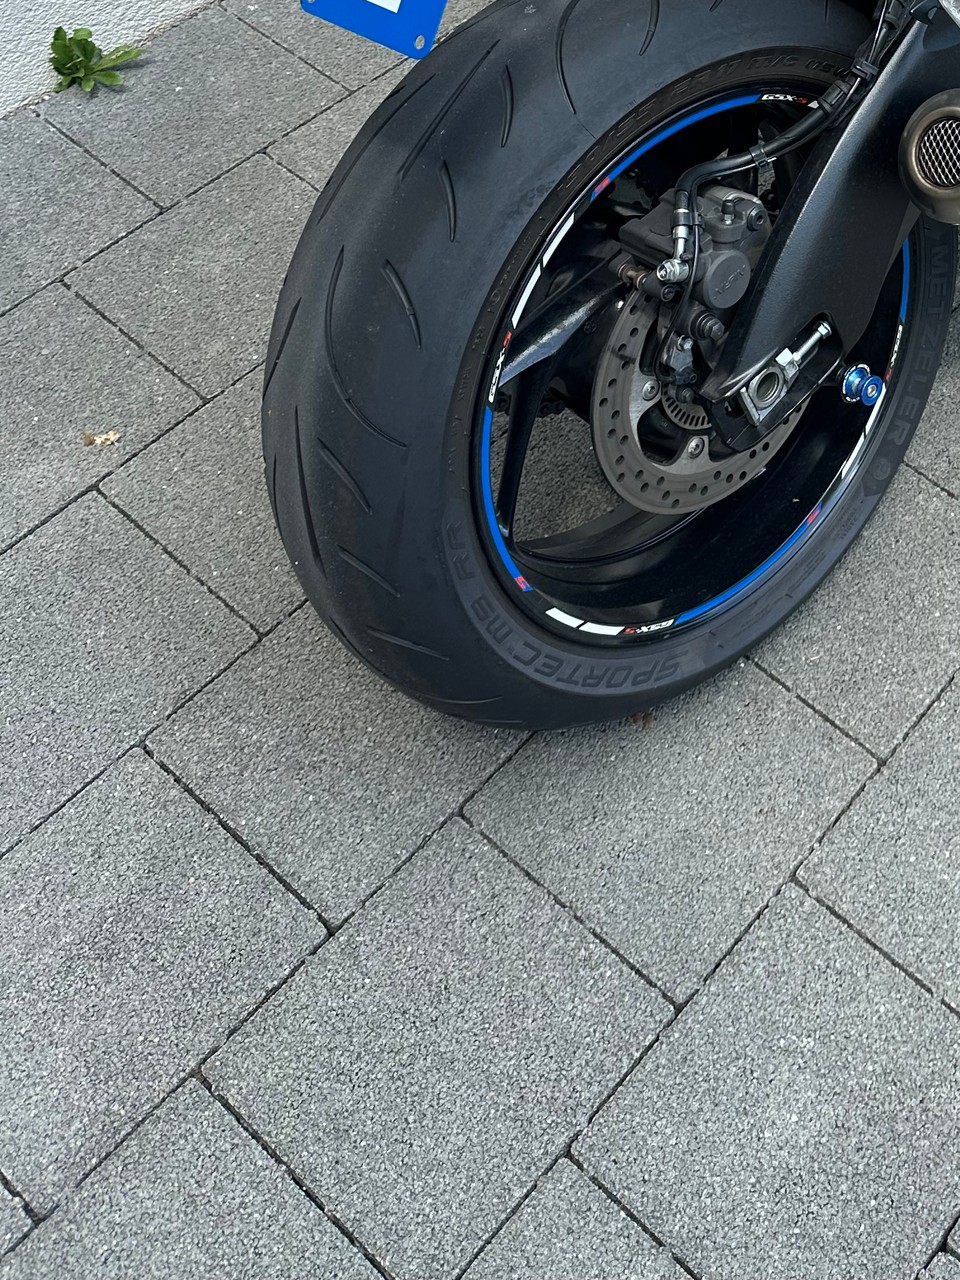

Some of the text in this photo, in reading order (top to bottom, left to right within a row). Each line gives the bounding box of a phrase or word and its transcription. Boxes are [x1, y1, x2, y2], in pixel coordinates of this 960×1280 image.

[760, 92, 809, 104] GSX-S
[887, 245, 949, 447] METZELER
[512, 640, 689, 689] SPORTEC
